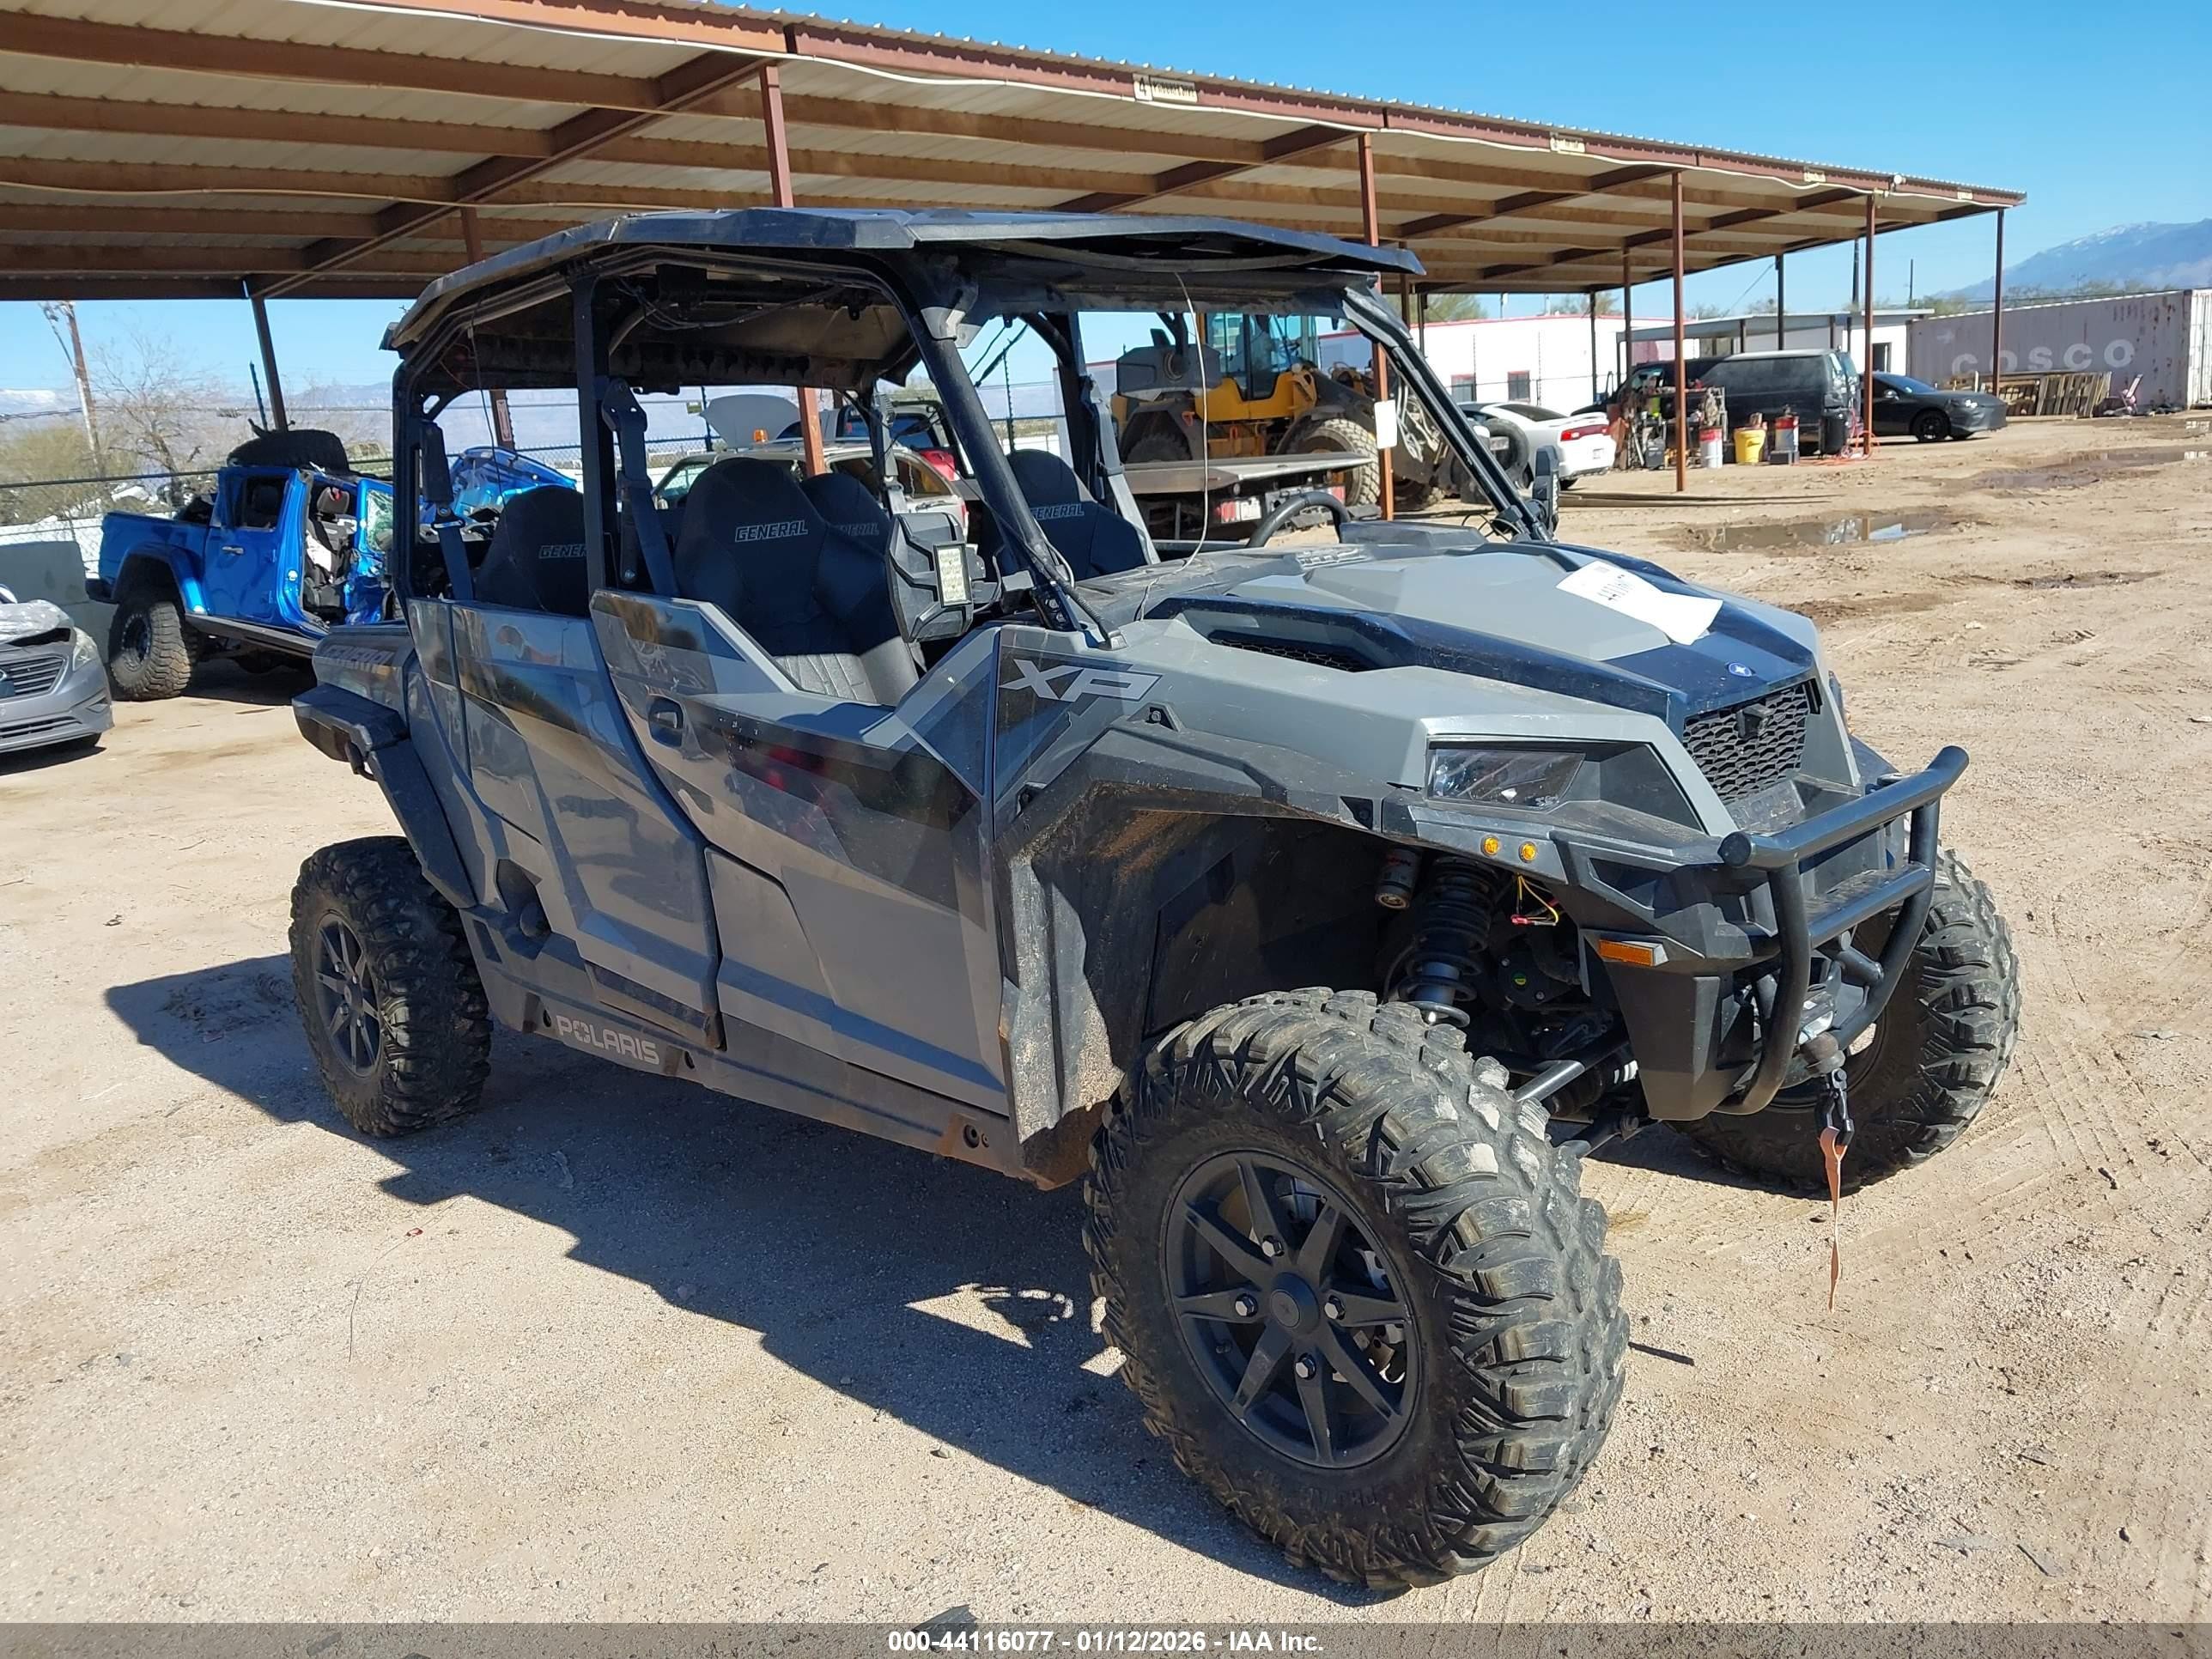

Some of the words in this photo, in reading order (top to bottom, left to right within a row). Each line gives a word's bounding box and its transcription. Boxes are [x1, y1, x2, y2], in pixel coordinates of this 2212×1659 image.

[1951, 338, 2136, 375] COSCO
[735, 520, 808, 542] GENERAL
[999, 659, 1162, 702] XP
[556, 1015, 659, 1065] POLARIS
